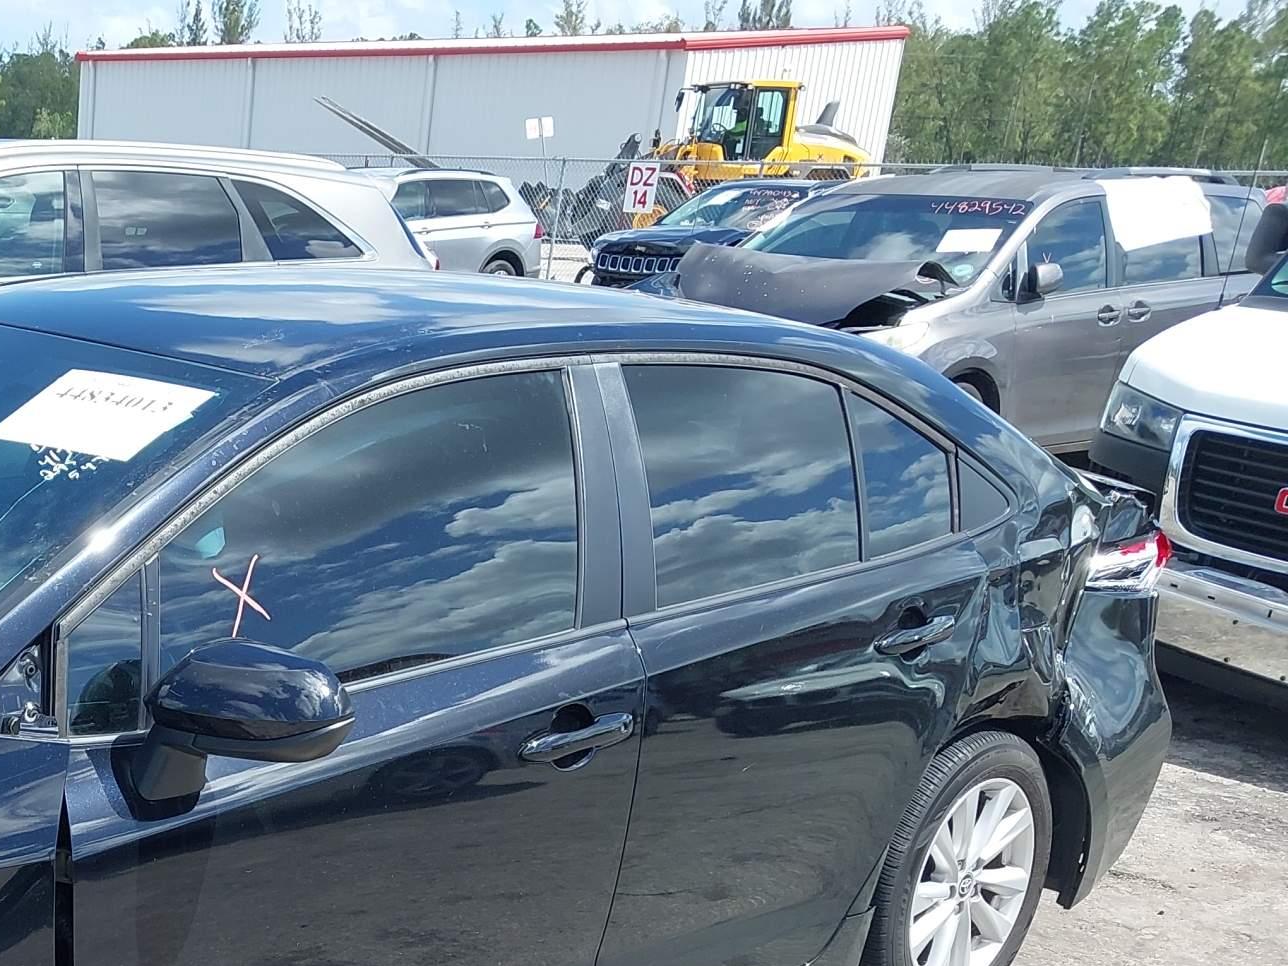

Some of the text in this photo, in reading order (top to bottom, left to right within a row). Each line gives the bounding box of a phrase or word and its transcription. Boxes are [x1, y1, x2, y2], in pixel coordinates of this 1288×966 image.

[630, 166, 657, 187] DZ
[633, 189, 648, 209] 14
[931, 200, 1026, 216] 44829542
